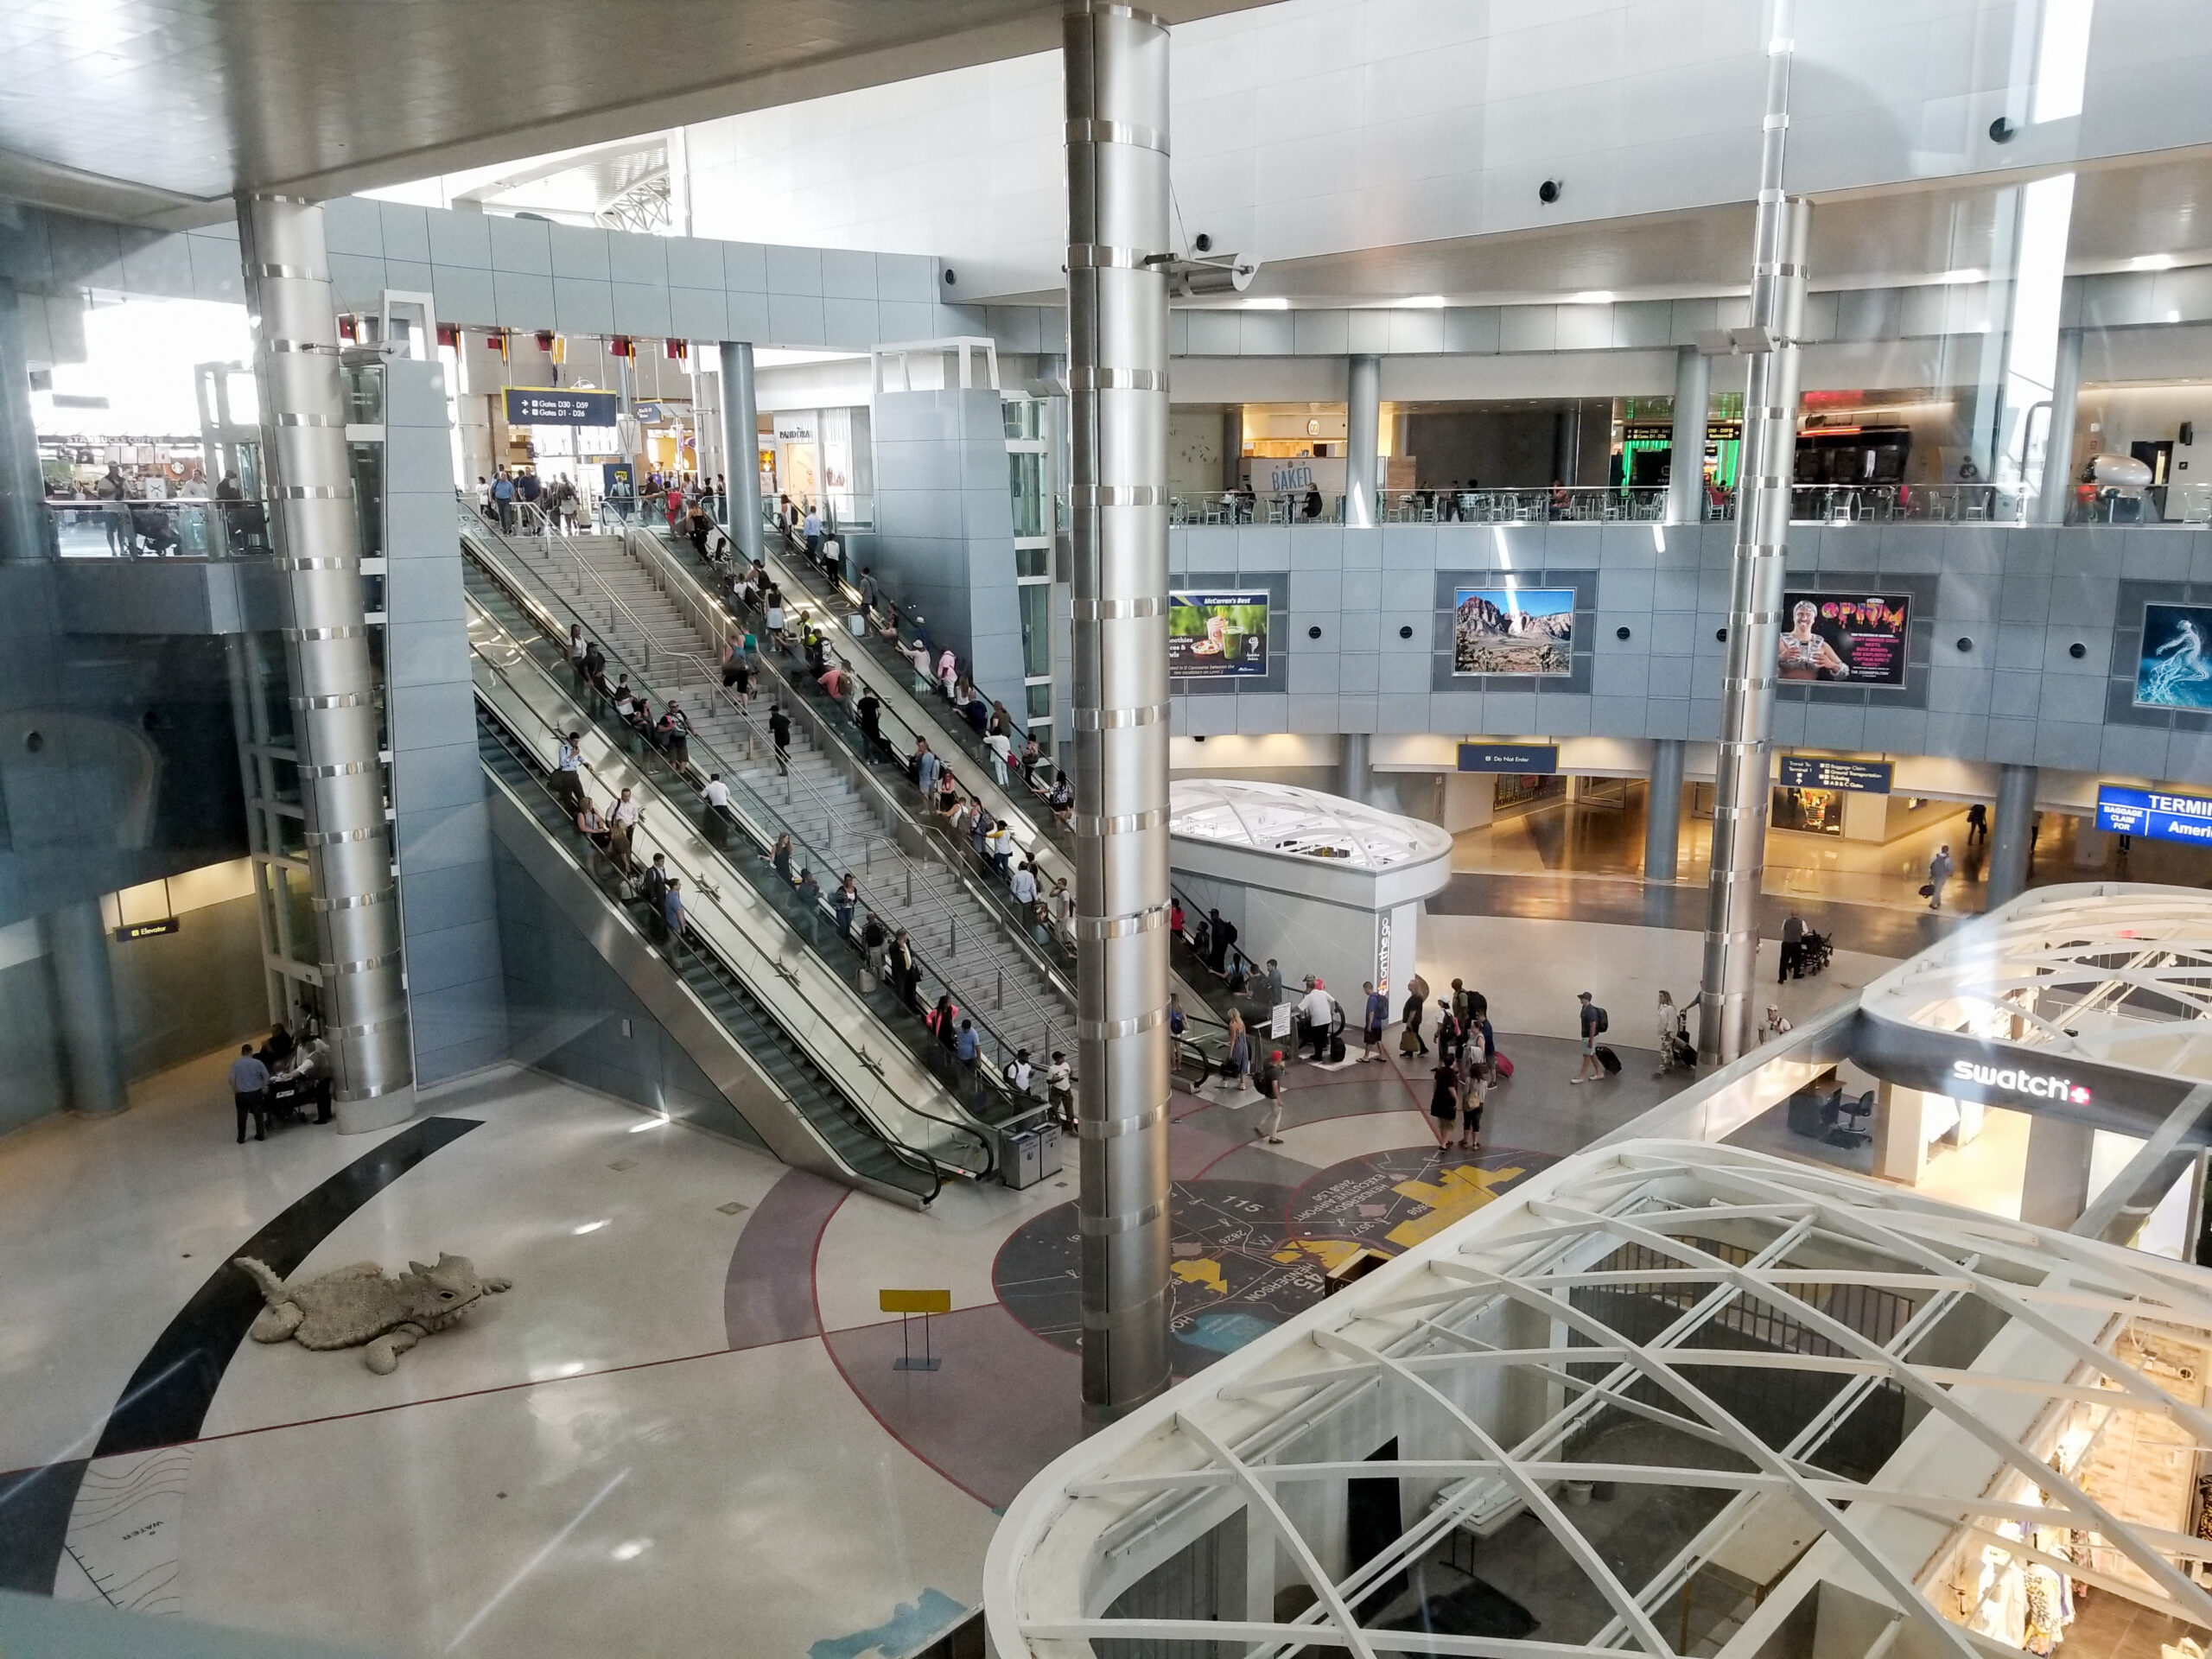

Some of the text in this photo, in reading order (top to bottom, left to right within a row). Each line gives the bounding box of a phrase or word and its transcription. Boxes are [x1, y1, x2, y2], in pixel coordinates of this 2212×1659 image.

[1272, 467, 1313, 492] BAKED
[2104, 806, 2143, 817] BAGGAGE
[2110, 814, 2135, 824] CLAIM
[2113, 823, 2131, 831] FOR
[2168, 821, 2212, 837] Ameri
[141, 926, 167, 935] Elevator
[1954, 1060, 2070, 1101] swatch
[1222, 1195, 1265, 1212] 115
[1293, 1173, 1387, 1222] EXECUTIVE AIRPORT
[1326, 1184, 1390, 1215] HENDERSON
[1218, 1230, 1248, 1244] 2826
[1244, 1262, 1317, 1301] HENDERSON
[122, 1521, 164, 1541] WATER
